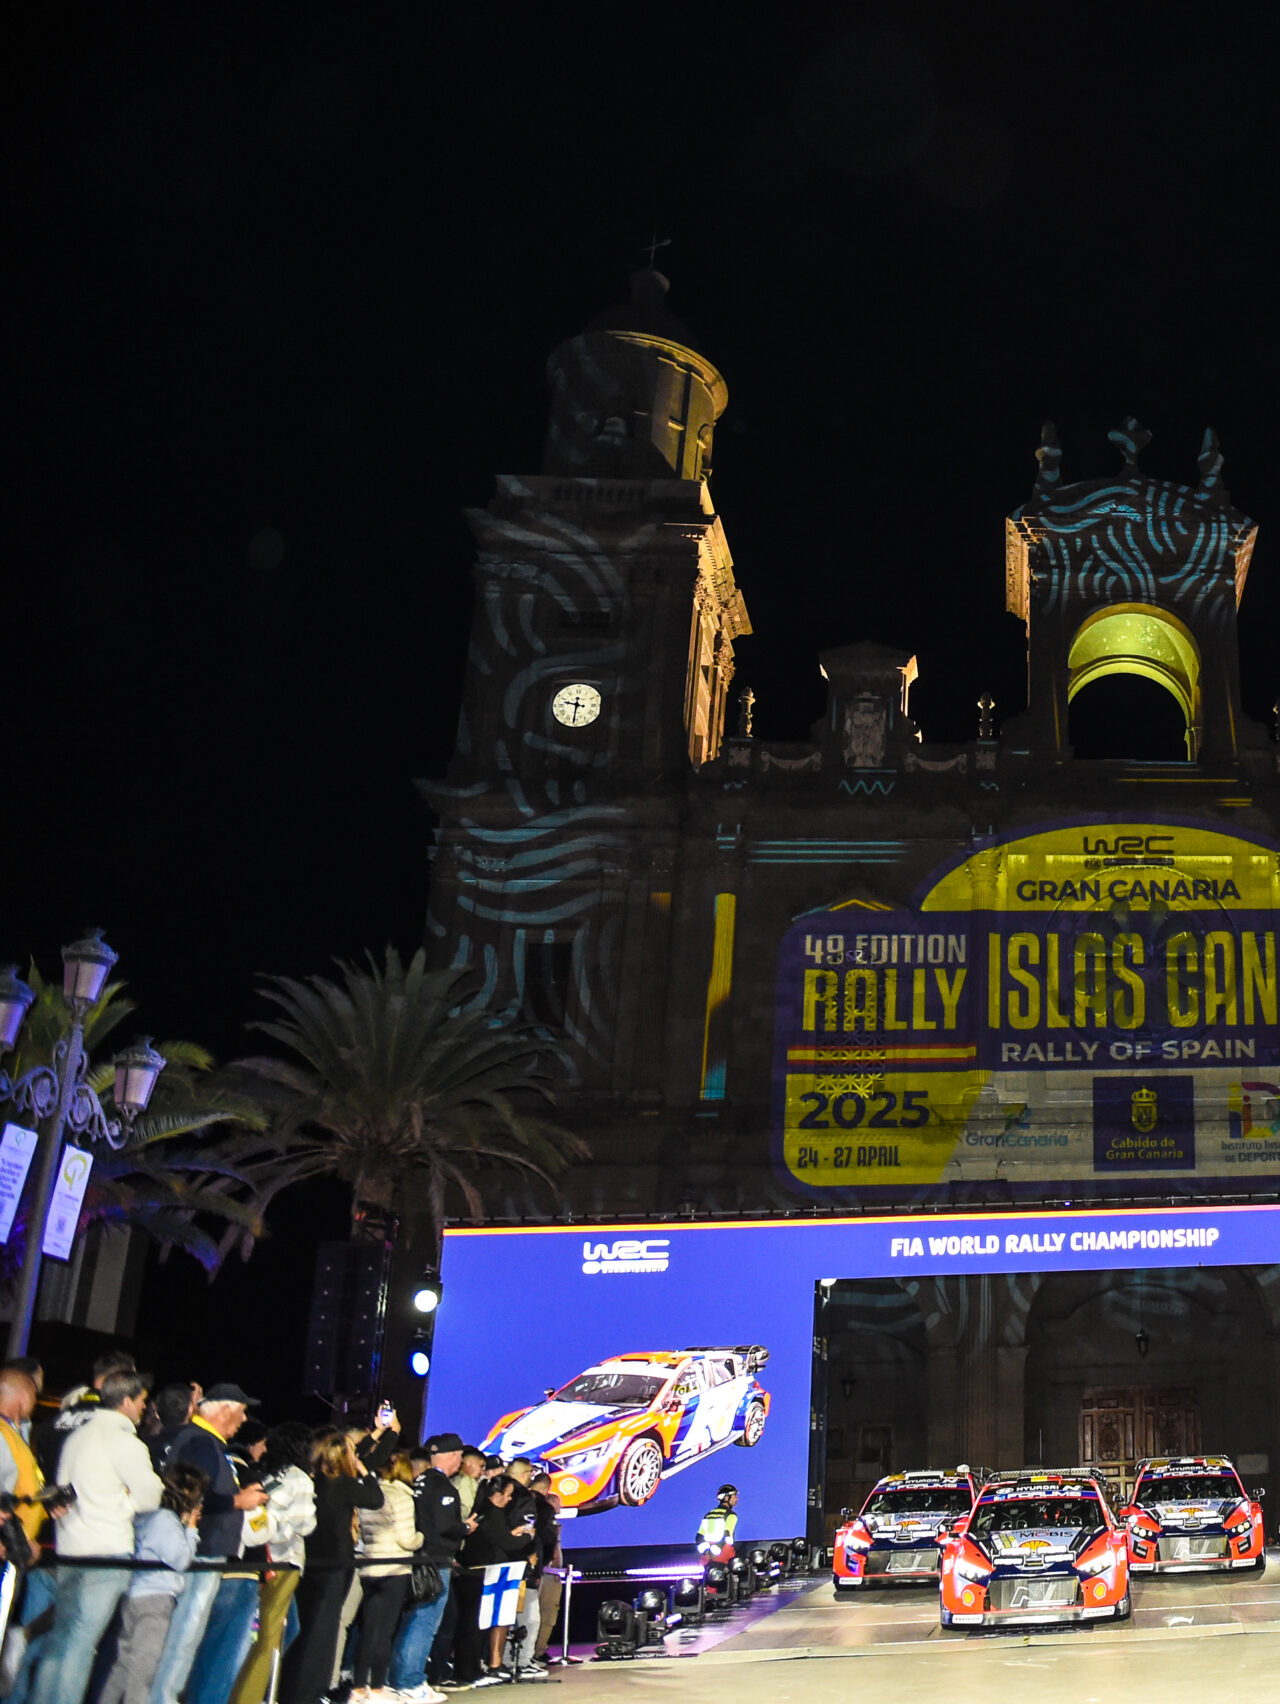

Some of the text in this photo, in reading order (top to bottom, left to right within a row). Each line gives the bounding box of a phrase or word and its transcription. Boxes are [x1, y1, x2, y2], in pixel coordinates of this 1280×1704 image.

[1083, 836, 1174, 854] WRC
[1016, 879, 1241, 901] GRAN CANARIA
[805, 934, 967, 964] 49 EDITION
[988, 931, 1146, 1029] ISLAS
[803, 968, 968, 1032] RALLY
[1001, 1038, 1256, 1062] RALLY OF SPAIN
[798, 1090, 931, 1129] 2025
[1111, 1137, 1175, 1148] Cabildo de
[798, 1147, 819, 1168] 24
[833, 1147, 853, 1168] 27
[857, 1146, 901, 1167] APRIL
[1106, 1149, 1184, 1160] Gran Canaria
[583, 1239, 670, 1260] WRC
[891, 1227, 1220, 1257] FIA WORLD RALLY CHAMPIONSHIP
